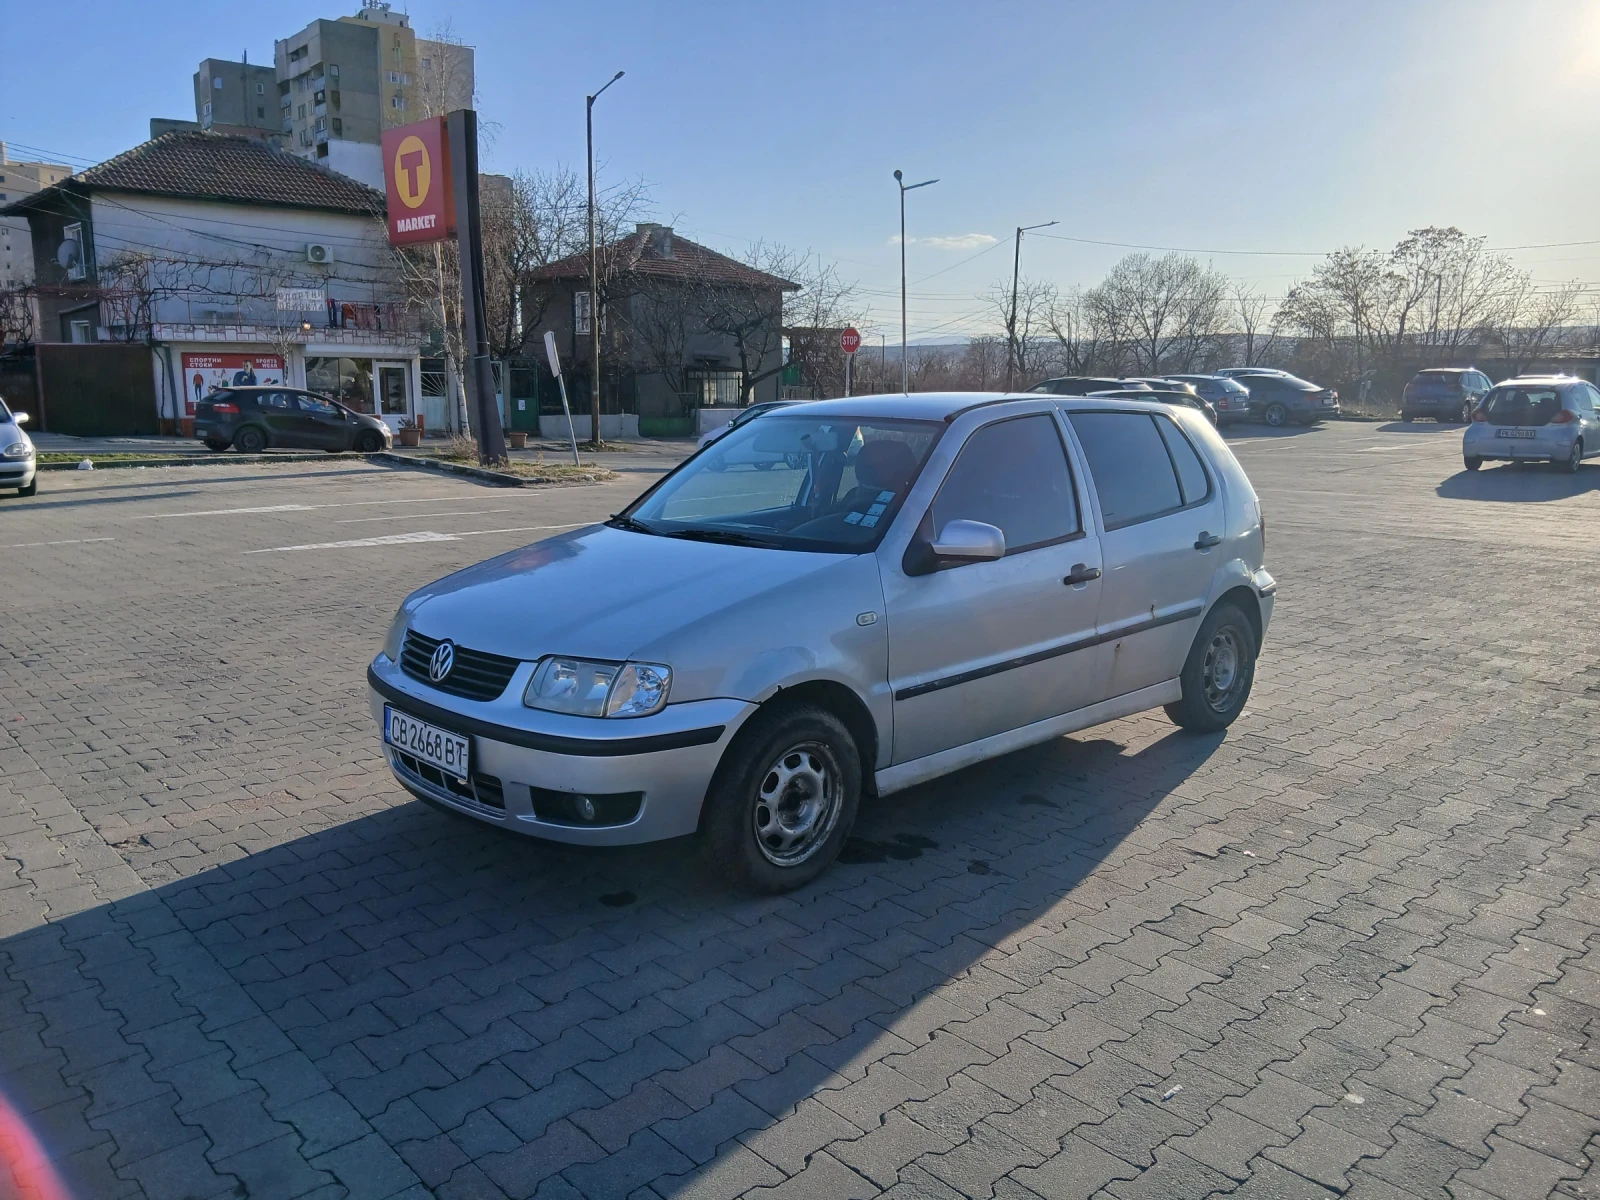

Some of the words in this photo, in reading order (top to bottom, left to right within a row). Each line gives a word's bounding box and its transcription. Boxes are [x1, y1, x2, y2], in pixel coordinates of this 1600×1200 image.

[400, 150, 423, 198] T
[397, 214, 436, 233] MARKET
[842, 336, 858, 346] STOP
[391, 715, 408, 746] CB
[409, 723, 442, 761] 2668
[445, 738, 466, 771] BT
